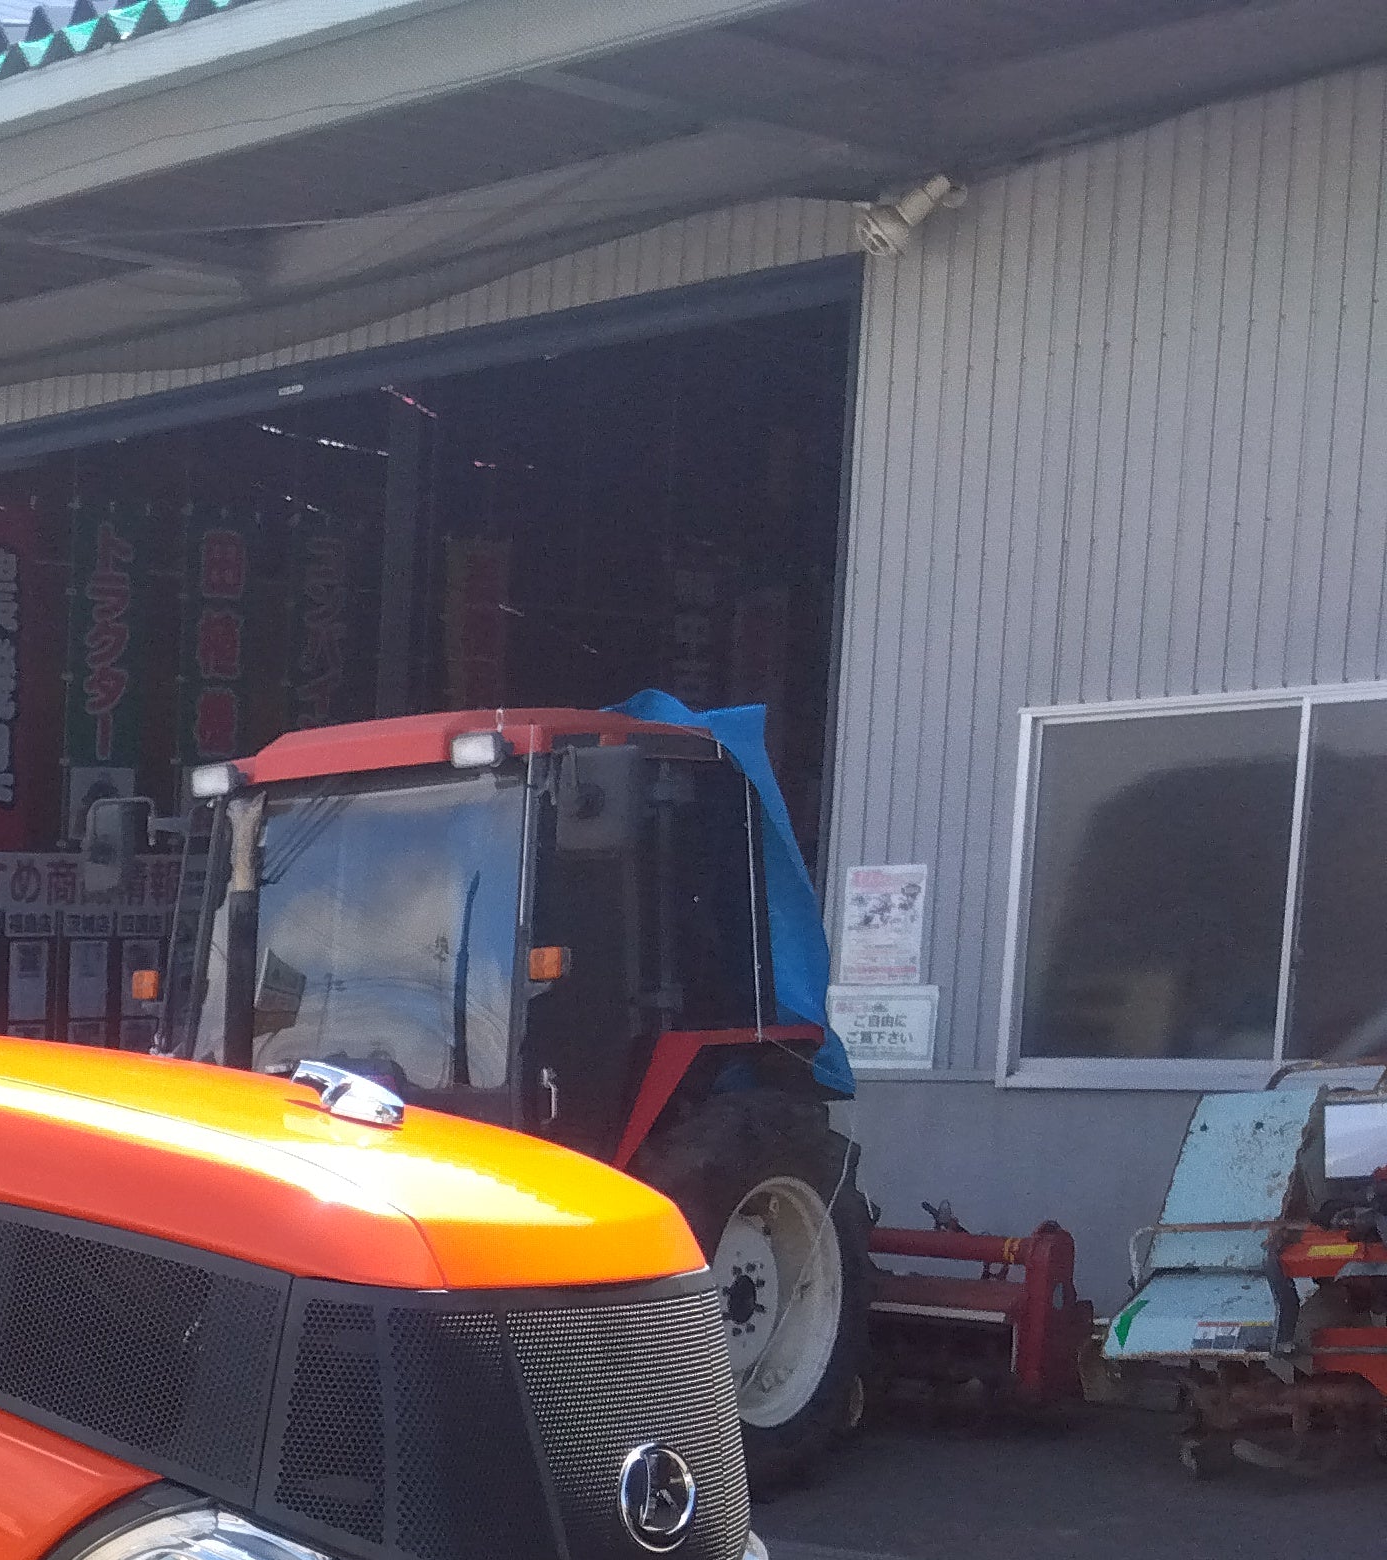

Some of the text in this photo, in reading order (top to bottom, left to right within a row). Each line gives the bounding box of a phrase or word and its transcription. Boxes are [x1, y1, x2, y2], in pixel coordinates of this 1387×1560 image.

[84, 522, 134, 761] トラクター
[853, 1014, 908, 1029] ご自由に
